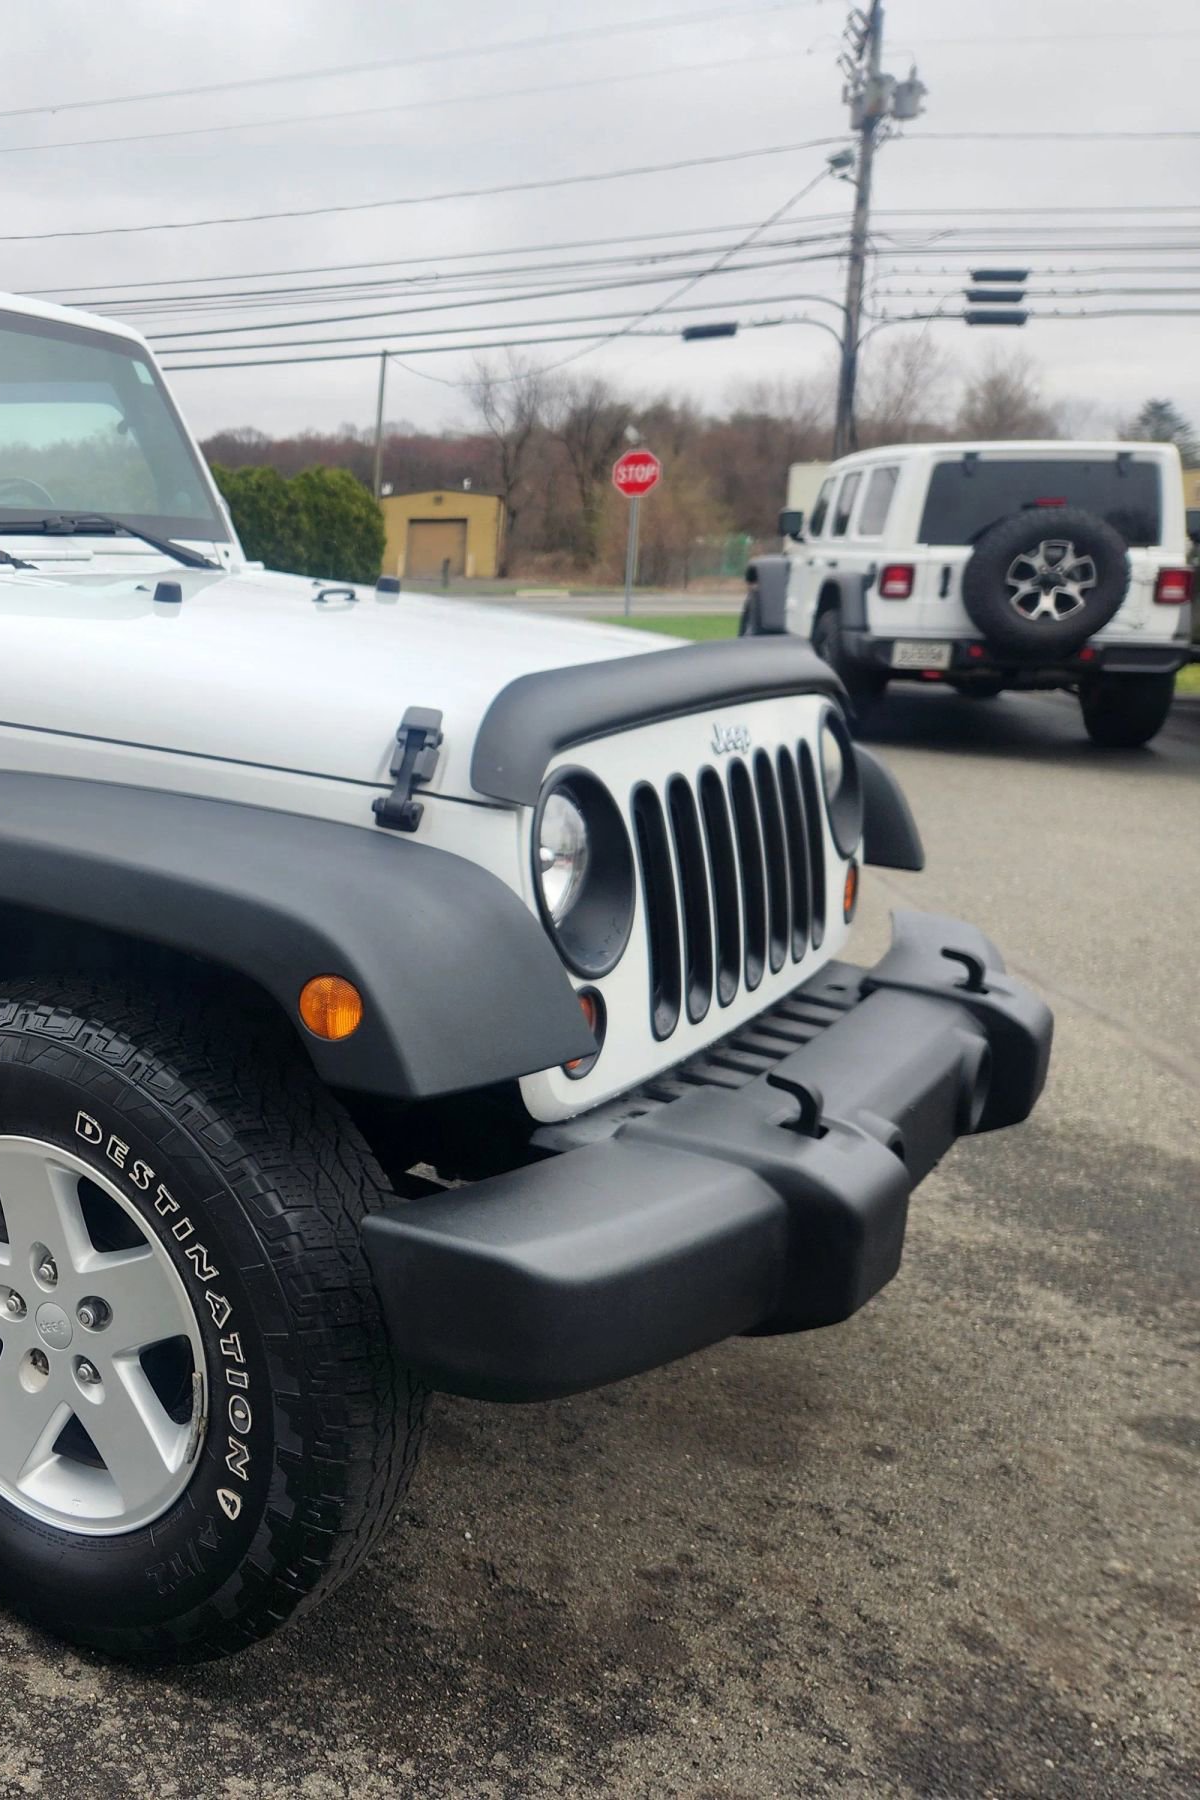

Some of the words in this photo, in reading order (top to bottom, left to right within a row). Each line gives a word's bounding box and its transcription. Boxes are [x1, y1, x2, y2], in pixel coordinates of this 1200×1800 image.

[616, 464, 657, 483] STOP
[711, 722, 751, 755] Jeep
[75, 1110, 255, 1481] DESTINATION
